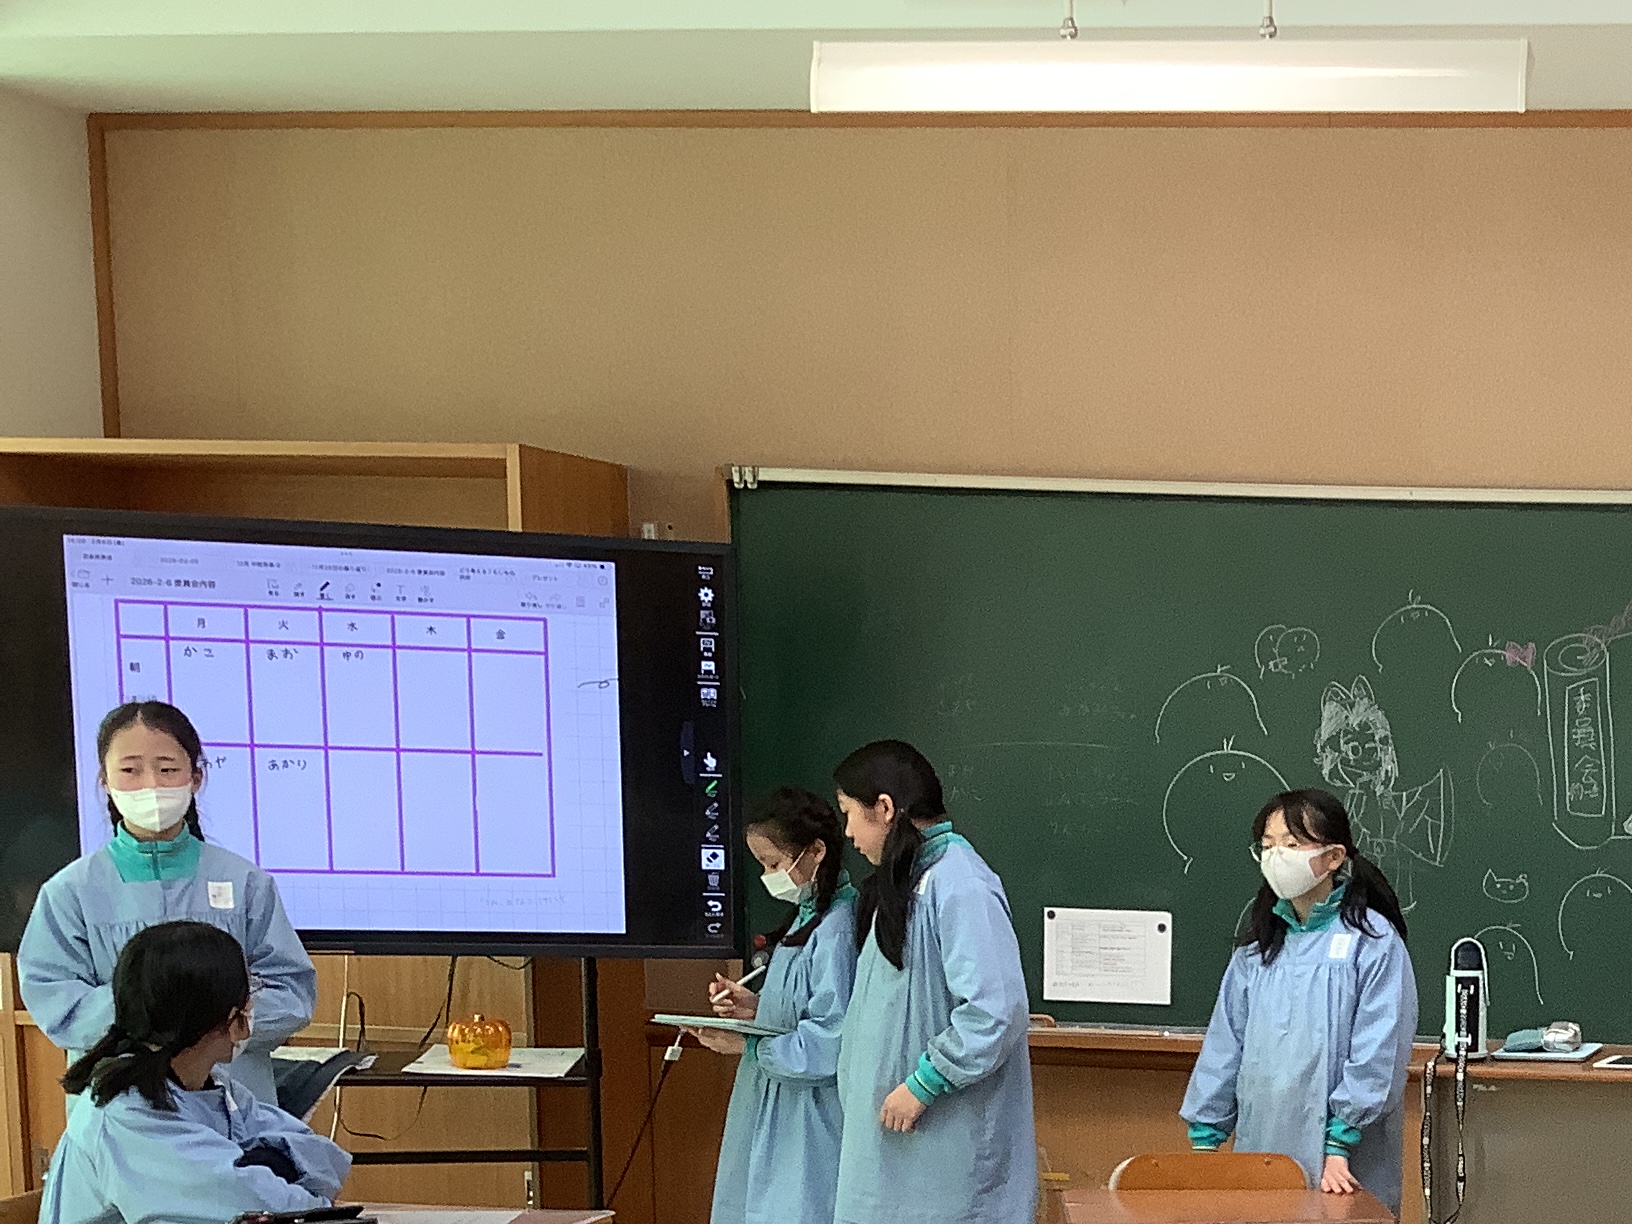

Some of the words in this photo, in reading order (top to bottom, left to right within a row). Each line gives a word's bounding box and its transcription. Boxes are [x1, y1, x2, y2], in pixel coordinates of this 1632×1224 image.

[196, 617, 206, 629] 月
[278, 619, 289, 630] 火
[347, 621, 358, 632] 水
[425, 625, 437, 636] 木
[268, 759, 308, 771] あかり
